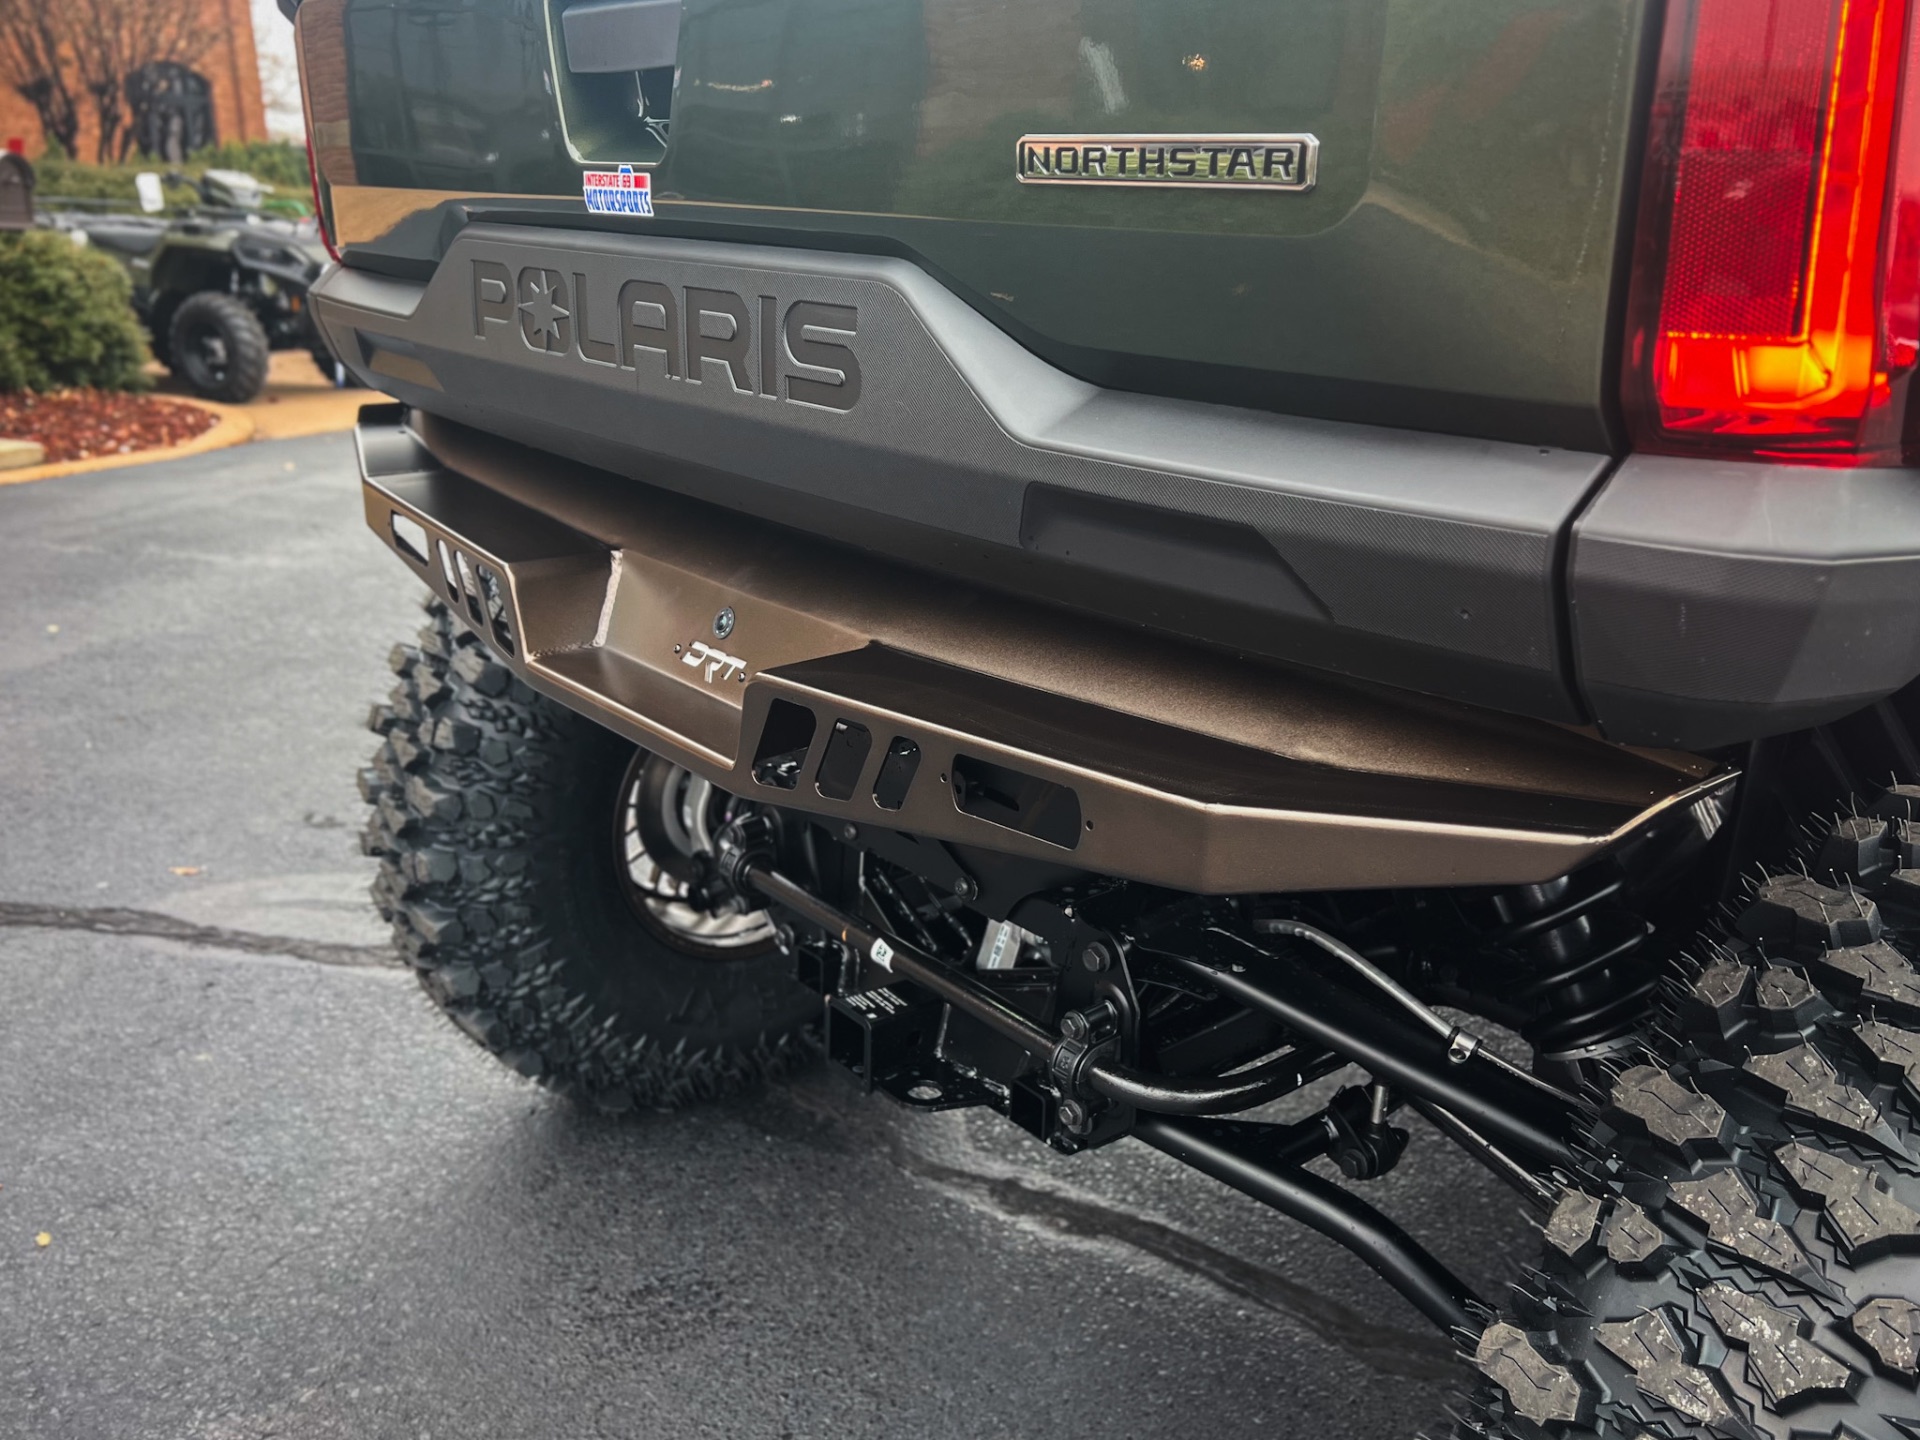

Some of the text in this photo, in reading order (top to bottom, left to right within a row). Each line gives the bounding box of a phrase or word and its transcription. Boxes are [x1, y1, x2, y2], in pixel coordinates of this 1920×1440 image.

[585, 173, 619, 187] INTERSTATE
[1026, 145, 1296, 180] NORTHSTAR
[585, 188, 652, 213] MOTORSPORTS
[470, 258, 864, 415] POLARIS
[681, 640, 748, 684] DRT
